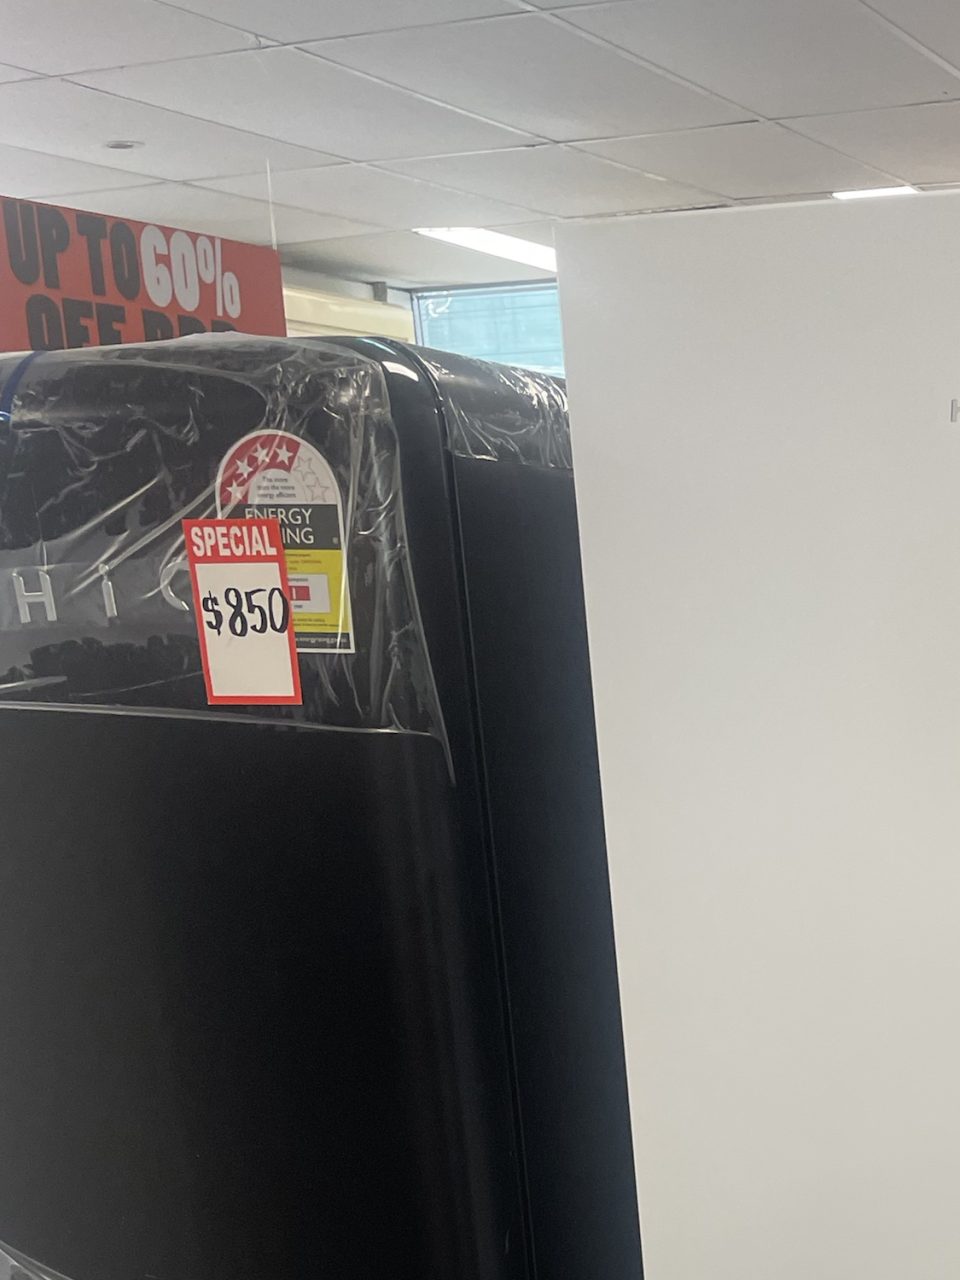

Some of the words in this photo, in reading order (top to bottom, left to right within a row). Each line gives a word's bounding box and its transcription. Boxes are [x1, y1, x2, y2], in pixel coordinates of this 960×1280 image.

[2, 200, 70, 289] UP
[76, 213, 141, 301] TO
[140, 224, 242, 319] 60%
[245, 508, 312, 524] ENERGY
[190, 525, 278, 557] SPECIAL
[282, 527, 315, 544] ING
[202, 587, 290, 637] $850
